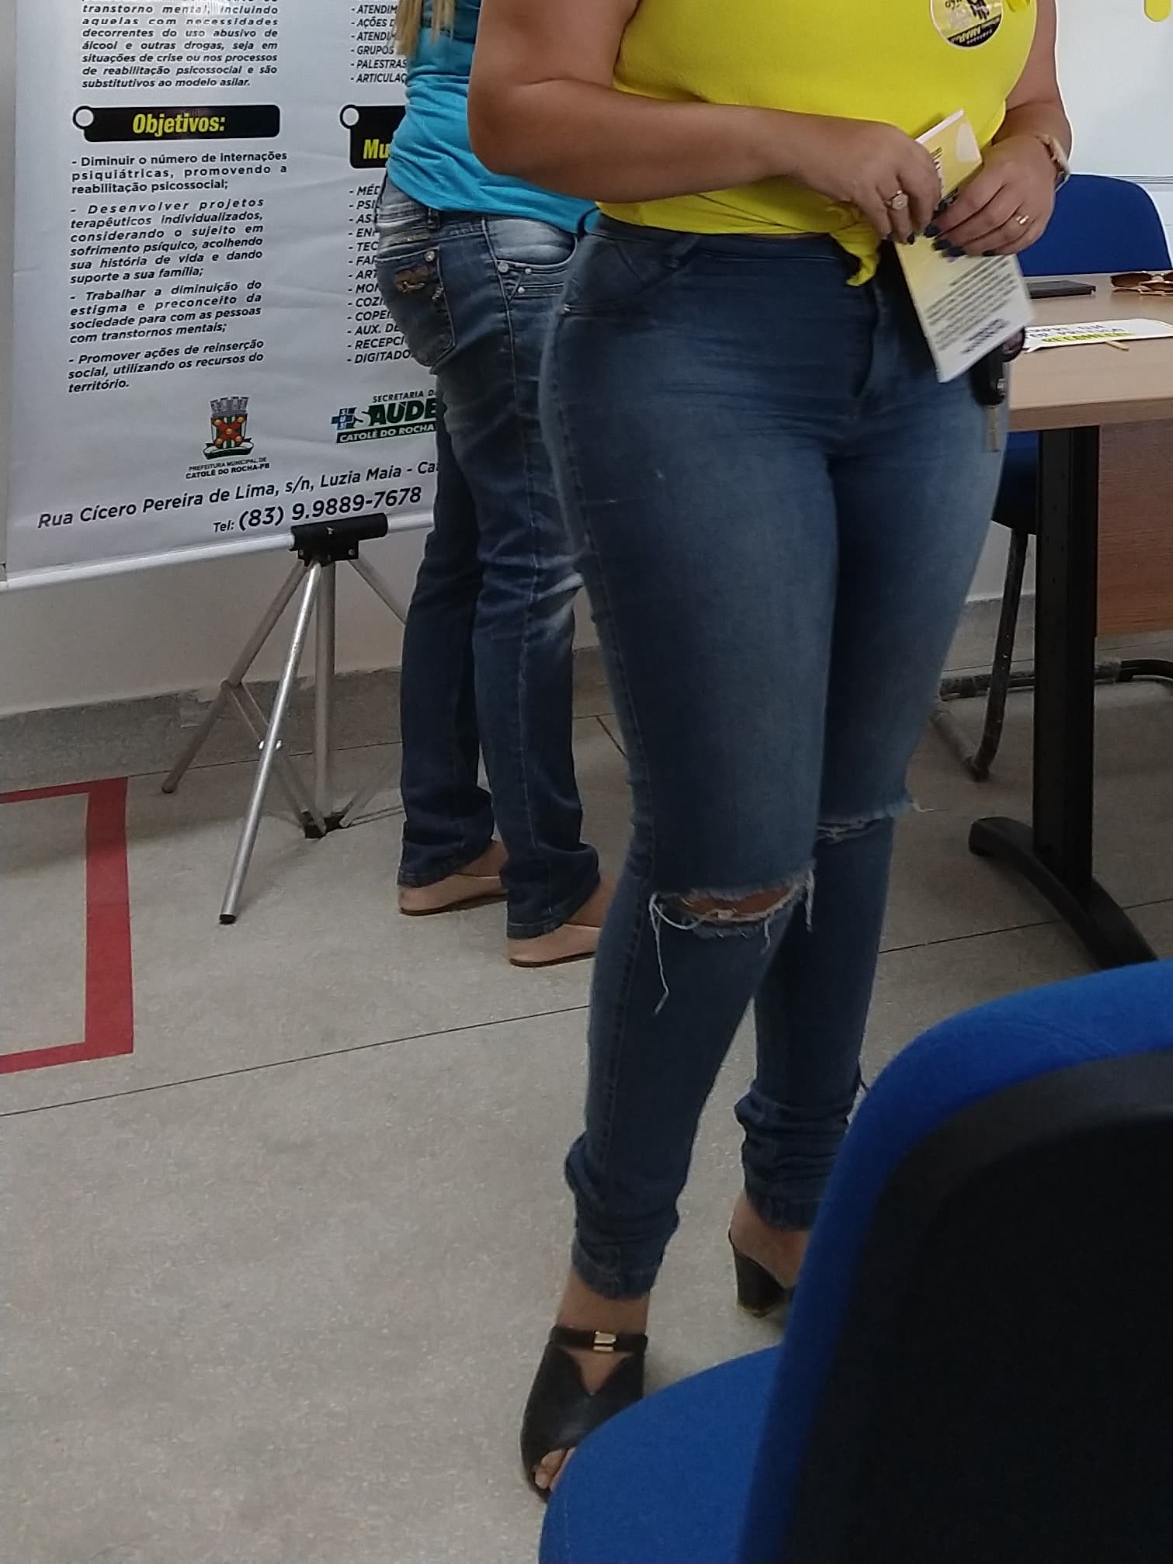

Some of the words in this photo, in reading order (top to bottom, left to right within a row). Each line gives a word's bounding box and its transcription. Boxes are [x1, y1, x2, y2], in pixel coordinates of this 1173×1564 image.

[83, 5, 153, 14] transtorno
[221, 6, 278, 15] incluindo
[82, 18, 139, 26] aquelas
[186, 18, 278, 26] necessidades
[357, 17, 387, 28] AÇÕES
[83, 29, 154, 37] decorrentes
[162, 29, 177, 37] do
[213, 29, 256, 37] abusivo
[264, 29, 278, 37] de
[82, 41, 118, 50] álcool
[141, 42, 176, 50] outras
[184, 41, 224, 51] drogas,
[232, 42, 254, 51] seja
[262, 42, 278, 50] em
[357, 46, 394, 54] GRUPOS
[82, 53, 135, 63] situações
[139, 54, 154, 62] de
[156, 54, 183, 62] crise
[225, 54, 277, 63] processos
[357, 60, 407, 69] PALESTRAS
[82, 67, 97, 75] de
[103, 66, 171, 75] reabilitação
[176, 66, 242, 76] psicossocial
[259, 66, 277, 74] são
[82, 79, 155, 88] substitutivos
[175, 78, 217, 87] modelo
[220, 78, 250, 87] asilar.
[133, 113, 226, 137] Objetivos:
[81, 156, 135, 167] Diminuir
[151, 154, 198, 165] número
[201, 153, 216, 163] de
[220, 151, 288, 162] internações
[72, 169, 174, 182] psiquiátricas,
[184, 165, 271, 178] promovendo
[72, 182, 148, 194] reabilitação
[151, 179, 228, 192] psicossocial;
[88, 202, 189, 215] Desenvolver
[199, 198, 264, 211] projetos
[71, 217, 151, 229] terapêuticos
[161, 211, 263, 225] individualizados,
[71, 229, 164, 243] considerando
[191, 226, 236, 237] sujeito
[245, 225, 263, 233] em
[70, 244, 140, 257] sofrimento
[143, 241, 198, 254] psíquico,
[202, 238, 263, 249] acolhendo
[70, 262, 92, 270] sua
[100, 257, 147, 268] história
[155, 255, 170, 265] de
[179, 254, 204, 263] vida
[227, 250, 263, 260] dando
[70, 272, 120, 285] suporte
[133, 271, 155, 279] sua
[159, 267, 203, 278] família;
[86, 289, 146, 301] Trabalhar
[171, 283, 238, 295] diminuição
[247, 280, 261, 290] do
[70, 304, 127, 316] estigma
[155, 296, 237, 311] preconceito
[247, 294, 261, 303] da
[69, 317, 135, 330] sociedade
[139, 316, 166, 326] para
[170, 313, 196, 322] com
[199, 312, 212, 320] as
[215, 307, 261, 320] pessoas
[70, 335, 97, 344] com
[101, 329, 173, 340] transtornos
[176, 322, 227, 335] mentais;
[355, 324, 381, 336] AUX.
[79, 352, 141, 364] Promover
[144, 347, 180, 359] ações
[184, 345, 199, 355] de
[203, 340, 264, 353] reinserção
[355, 350, 411, 364] DIGITADO
[68, 366, 108, 379] social,
[113, 361, 175, 375] utilizando
[179, 360, 192, 368] os
[196, 356, 245, 367] recursos
[249, 352, 264, 362] do
[68, 380, 129, 393] território.
[373, 390, 424, 403] SECRETARIA
[381, 429, 396, 437] DO
[399, 424, 435, 435] ROCHA
[189, 462, 226, 471] PREFEITURA
[226, 458, 258, 467] MUNICIPAL
[37, 511, 73, 529] Rua
[80, 502, 137, 523] Cícero
[143, 493, 203, 514] Pereira
[209, 490, 230, 503] de
[235, 482, 280, 500] Lima,
[285, 476, 315, 494] s/n,
[320, 470, 361, 488] Luzia
[366, 464, 402, 482] Maia
[213, 520, 235, 533] Tel:
[238, 506, 285, 532] (83)
[291, 487, 422, 521] 9.9889-7678
